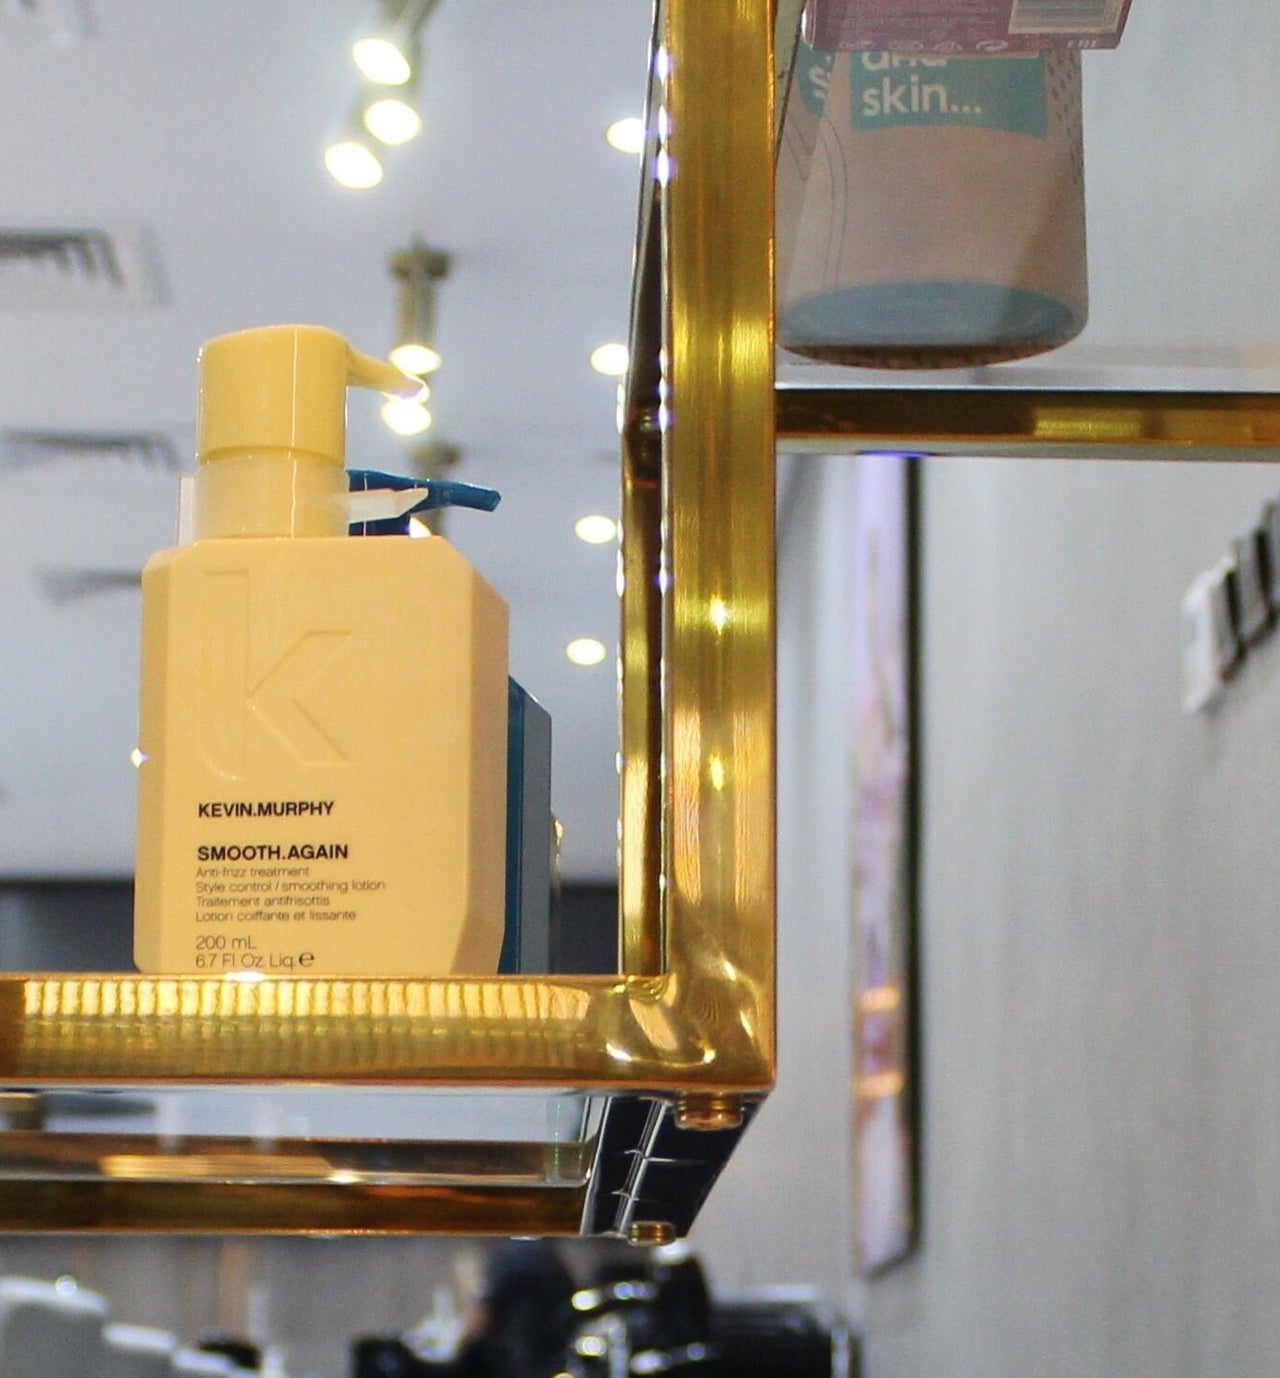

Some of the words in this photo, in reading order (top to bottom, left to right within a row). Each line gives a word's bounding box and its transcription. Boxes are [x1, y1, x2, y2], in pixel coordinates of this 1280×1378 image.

[862, 74, 983, 117] skin...
[198, 802, 334, 818] KEVIN.MURPHY
[197, 844, 348, 861] SMOOTH.AGAIN
[250, 866, 309, 877] treatment
[196, 881, 225, 895] Style
[229, 881, 272, 893] control
[282, 880, 348, 895] smoothing
[352, 879, 386, 891] lotion
[197, 896, 260, 907] Traitement
[264, 894, 330, 906] antifrisottis
[196, 911, 233, 923] Lotion
[237, 909, 290, 922] coiffante
[293, 911, 306, 921] et
[310, 909, 357, 921] lissante
[196, 935, 226, 950] 200
[232, 935, 257, 950] mL
[196, 953, 217, 968] 6.7
